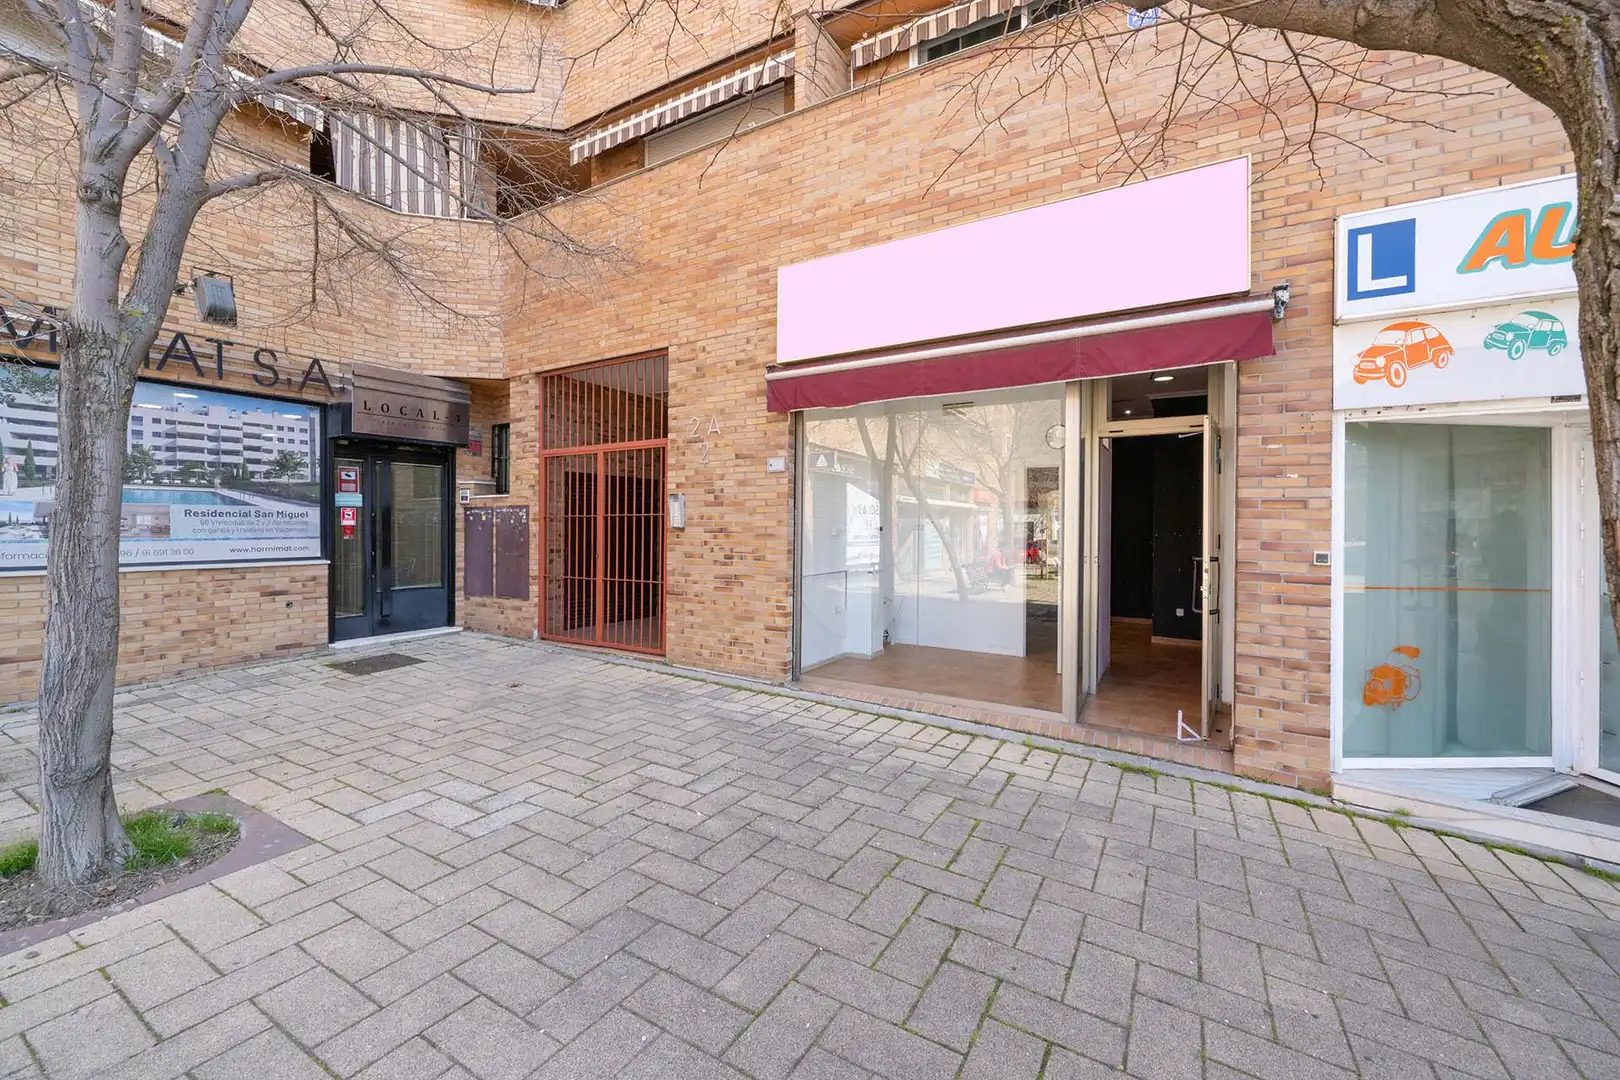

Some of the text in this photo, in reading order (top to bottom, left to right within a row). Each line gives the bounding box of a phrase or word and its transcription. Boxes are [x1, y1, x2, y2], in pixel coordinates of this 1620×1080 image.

[1357, 232, 1408, 293] L
[184, 508, 309, 520] Residencial San Miguel
[229, 545, 310, 553] www.hormimat.com
